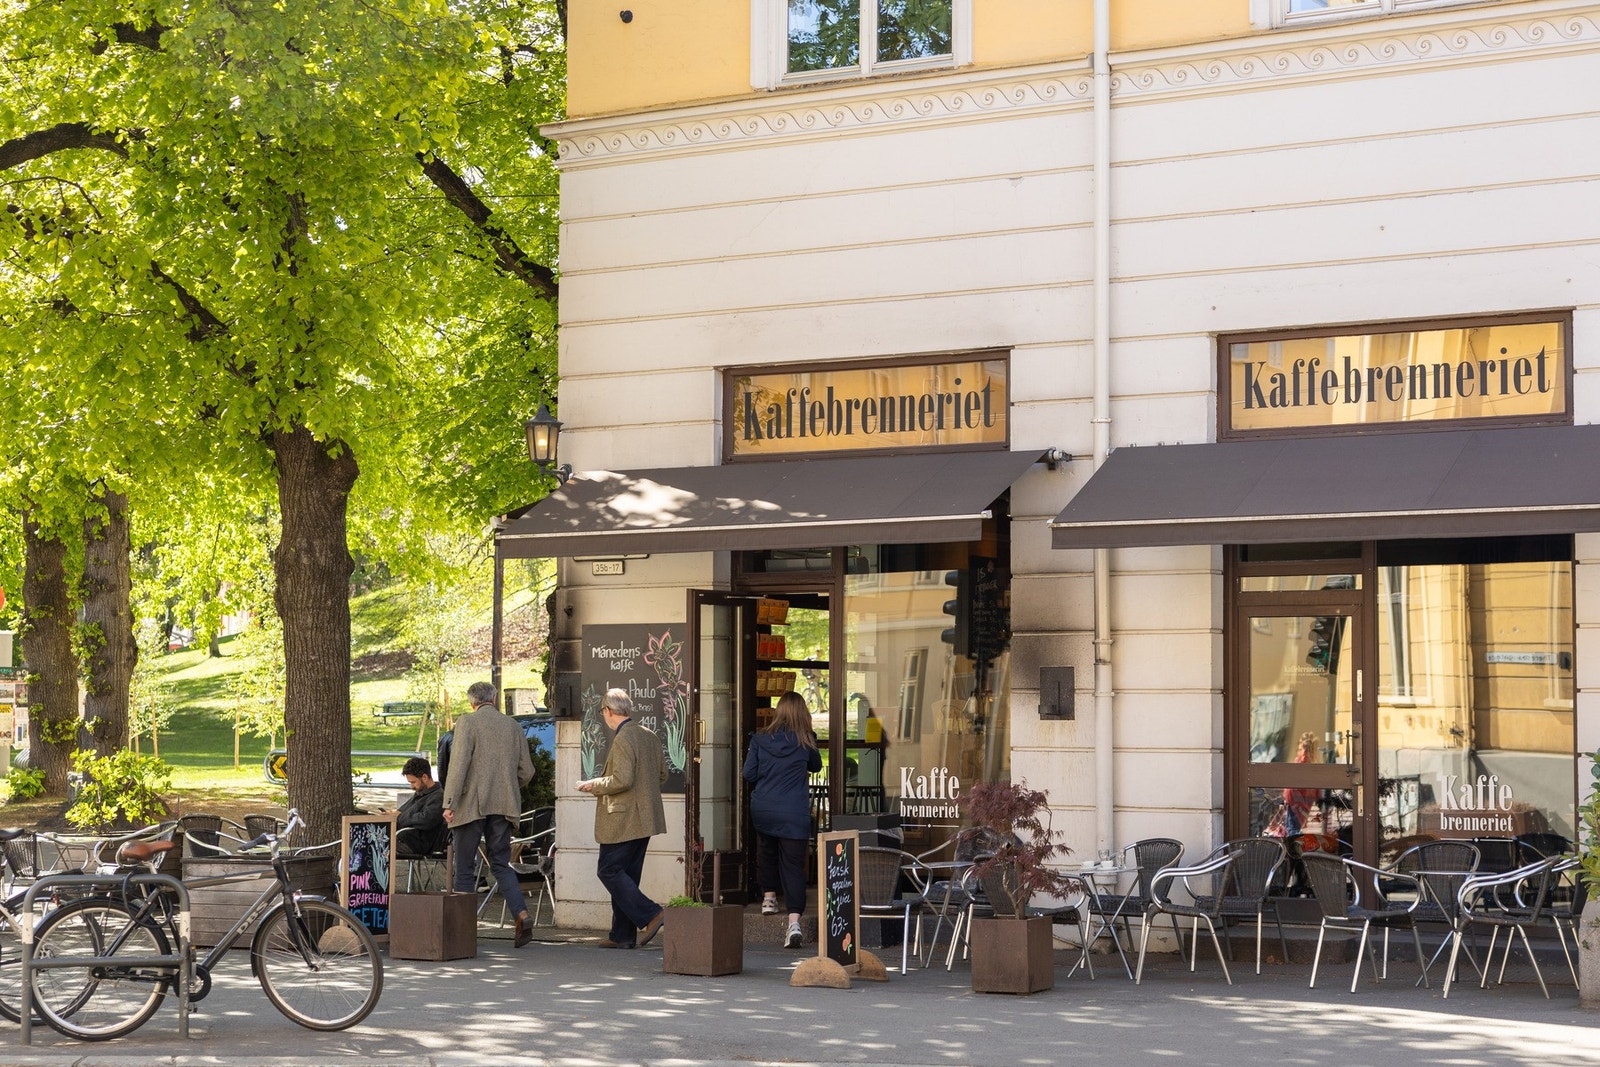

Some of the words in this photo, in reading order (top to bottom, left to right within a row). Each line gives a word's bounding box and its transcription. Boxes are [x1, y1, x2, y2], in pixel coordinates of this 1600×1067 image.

[1242, 344, 1550, 410] Kaffebrenneriet
[743, 376, 996, 441] Kaffebrenneriet
[610, 659, 635, 673] kaffe
[900, 766, 960, 800] Kaffe
[1439, 774, 1514, 811] Kaffe
[900, 800, 960, 819] brenneriet
[1440, 812, 1514, 832] brenneriet
[350, 871, 371, 891] PINK
[349, 892, 389, 908] GRAPEFRUIT
